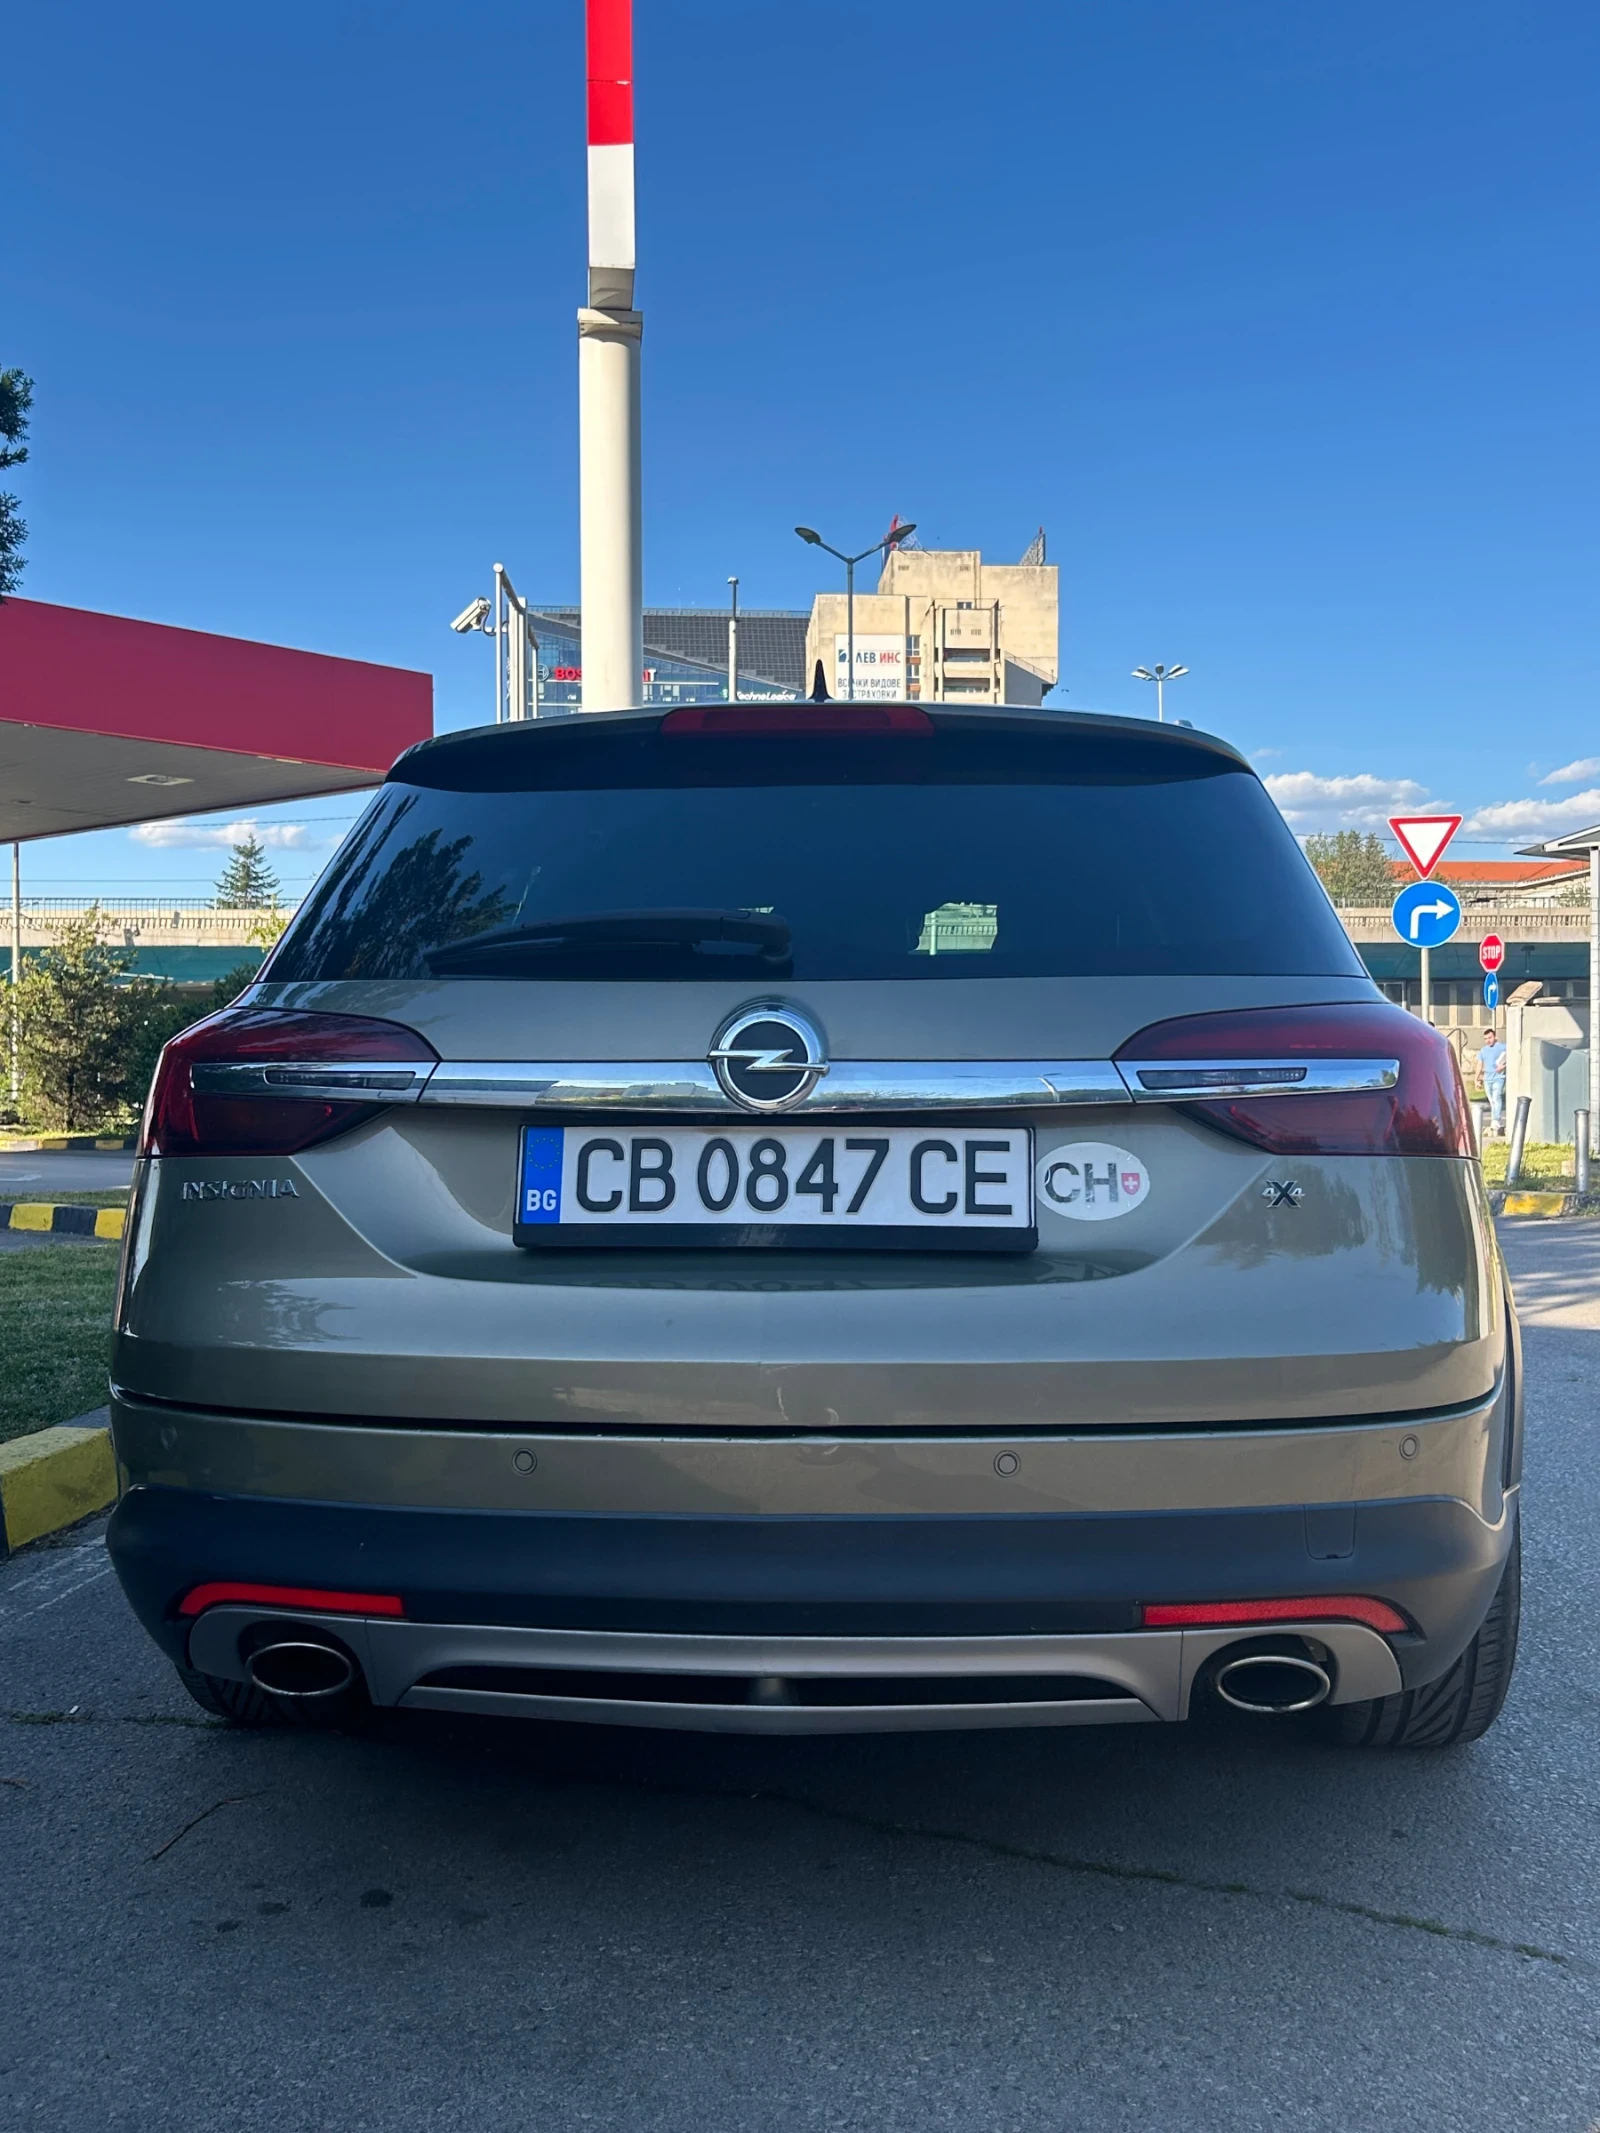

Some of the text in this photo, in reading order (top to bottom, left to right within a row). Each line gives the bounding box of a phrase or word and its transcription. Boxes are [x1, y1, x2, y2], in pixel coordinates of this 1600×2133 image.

[855, 652, 901, 663] ЛЕВ ИНС
[838, 678, 901, 688] ВСЧКИ ВИДОВЕ
[842, 689, 897, 699] ЗСТРАХОВКИ
[1482, 945, 1501, 960] STOP
[576, 1138, 1012, 1215] CB 0847 CE
[1044, 1162, 1119, 1203] CH
[182, 1179, 300, 1200] INSIGNIA
[526, 1189, 557, 1211] BG
